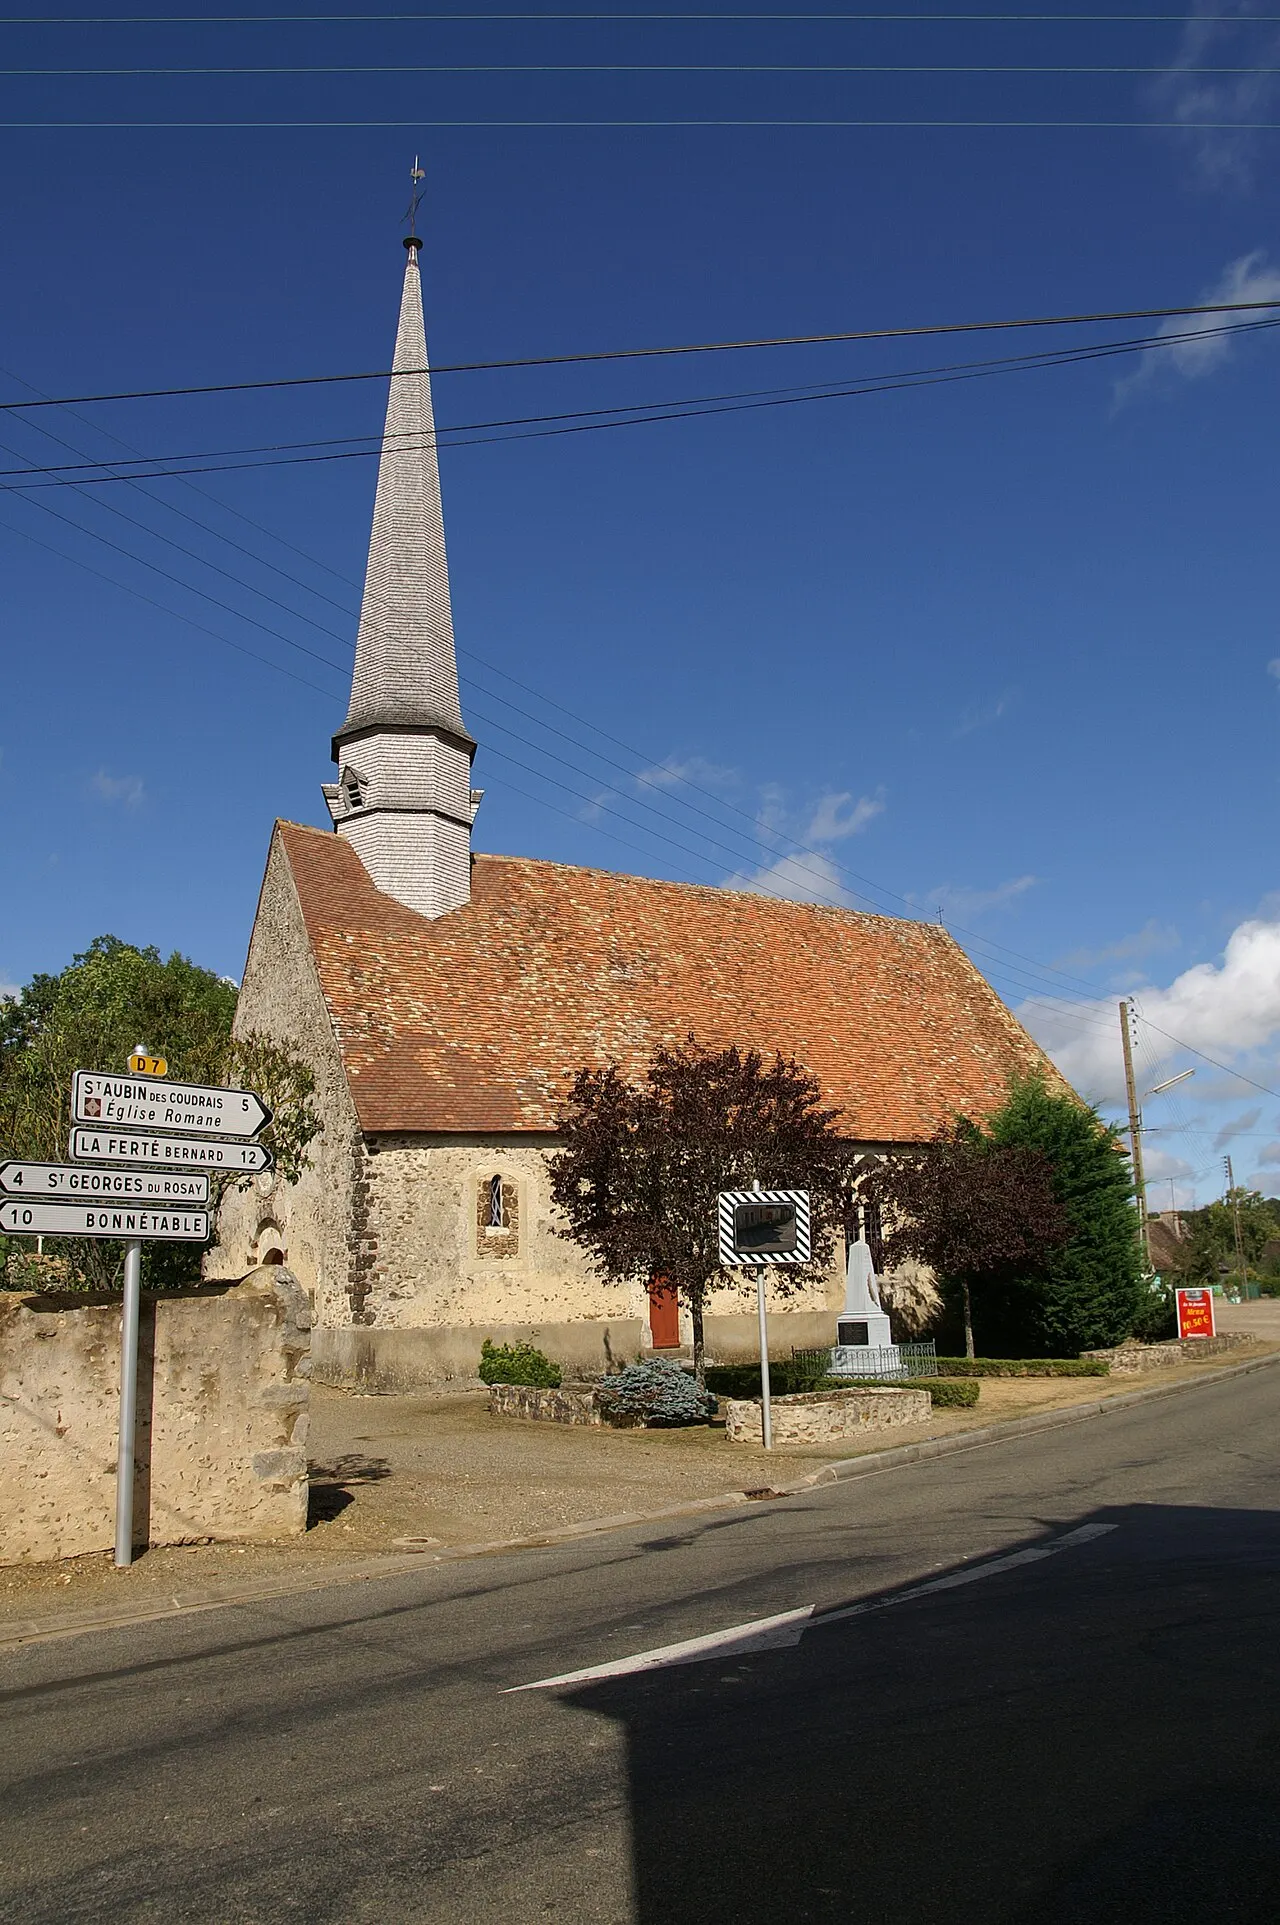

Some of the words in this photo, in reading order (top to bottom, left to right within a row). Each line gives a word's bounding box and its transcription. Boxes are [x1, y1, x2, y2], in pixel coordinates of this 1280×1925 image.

[137, 1058, 146, 1071] D
[151, 1059, 159, 1073] 7
[103, 1084, 147, 1100] AUBIN
[150, 1092, 167, 1103] DES
[169, 1093, 223, 1109] COUDRAIS
[242, 1099, 249, 1112] 5
[106, 1099, 156, 1121] Église
[164, 1108, 222, 1127] Romane
[81, 1137, 100, 1153] LA
[109, 1139, 159, 1157] FERTÉ
[165, 1146, 223, 1161] BERNARD
[241, 1151, 256, 1164] 12
[13, 1171, 24, 1186] 4
[69, 1176, 143, 1192] GEORGES
[148, 1183, 160, 1193] DU
[164, 1183, 202, 1194] ROSAY
[10, 1209, 33, 1224] 10
[86, 1213, 202, 1232] BONNÉTABLE
